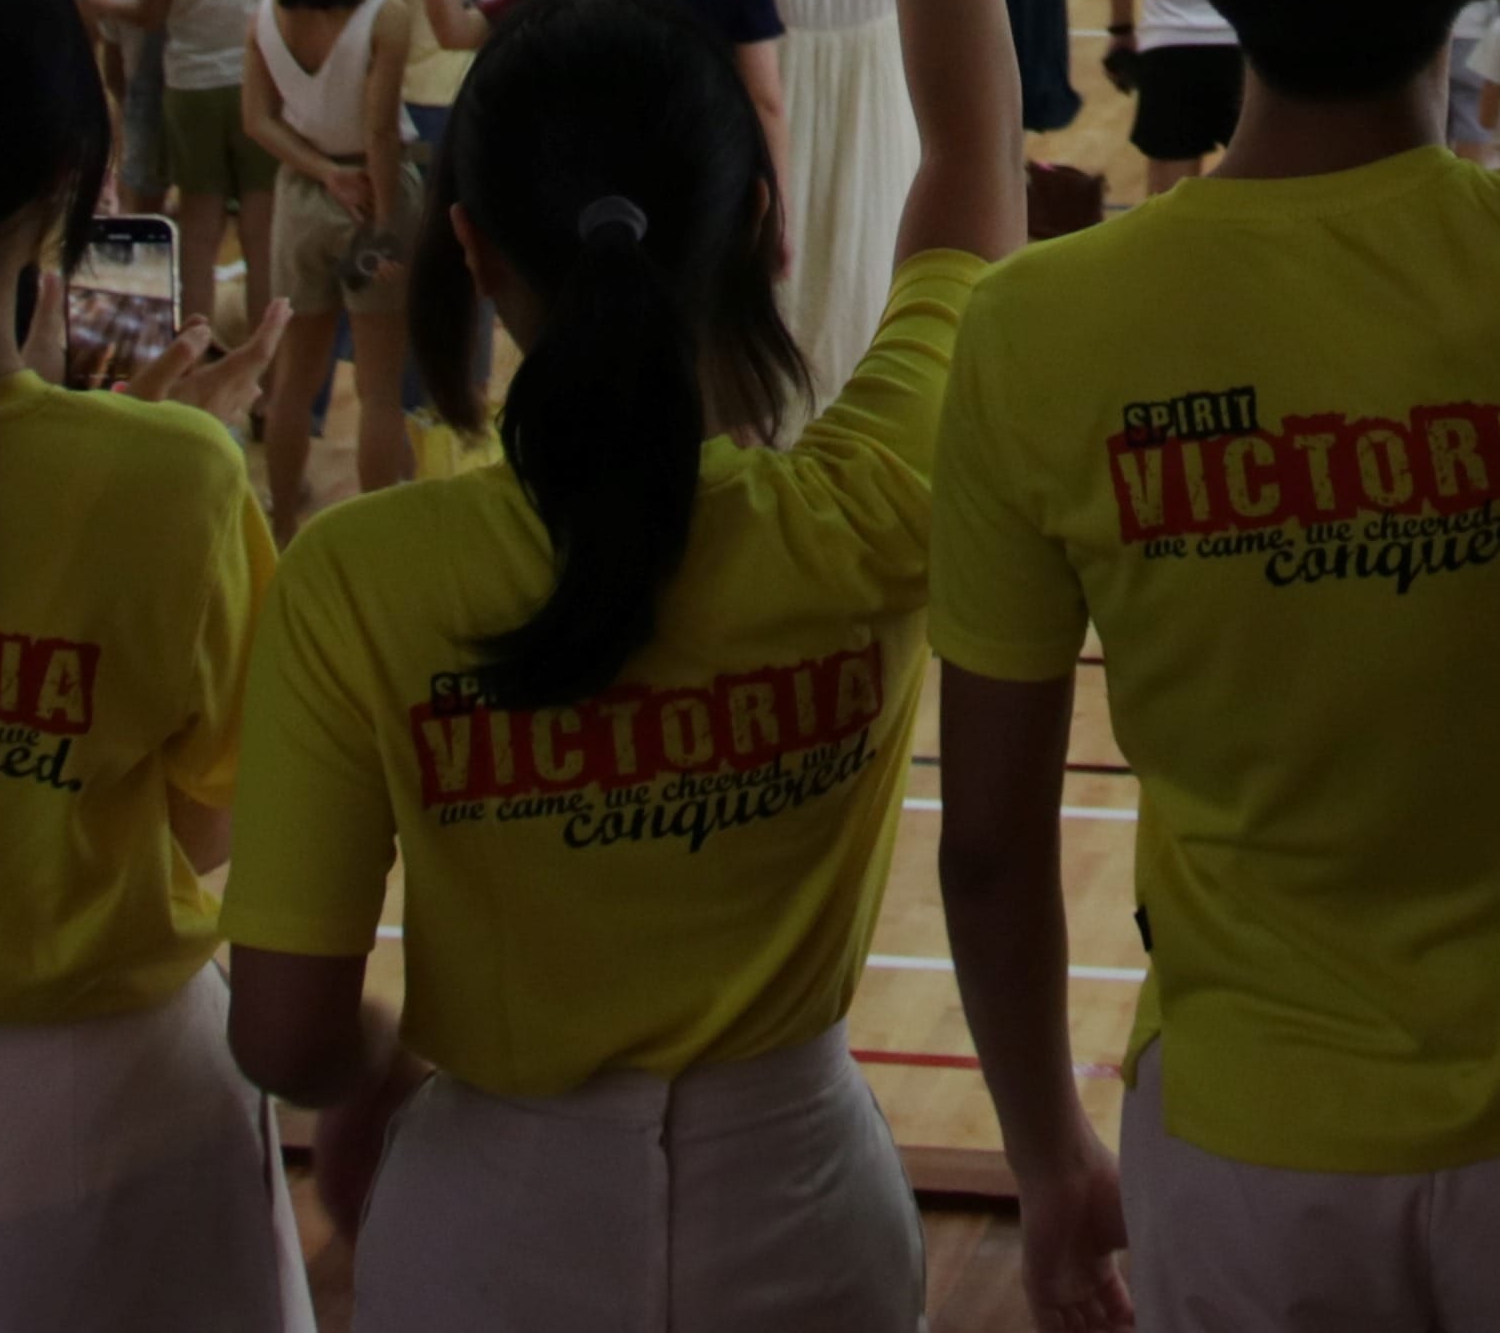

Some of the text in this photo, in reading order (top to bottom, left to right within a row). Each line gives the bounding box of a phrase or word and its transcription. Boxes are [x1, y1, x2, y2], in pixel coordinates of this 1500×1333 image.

[1125, 393, 1255, 440] SPIRIT
[1143, 535, 1190, 559] we
[1306, 519, 1354, 544] we
[422, 656, 879, 792] VICTORIA
[438, 800, 485, 827] we
[605, 785, 650, 808] we
[563, 727, 877, 852] conquered.
